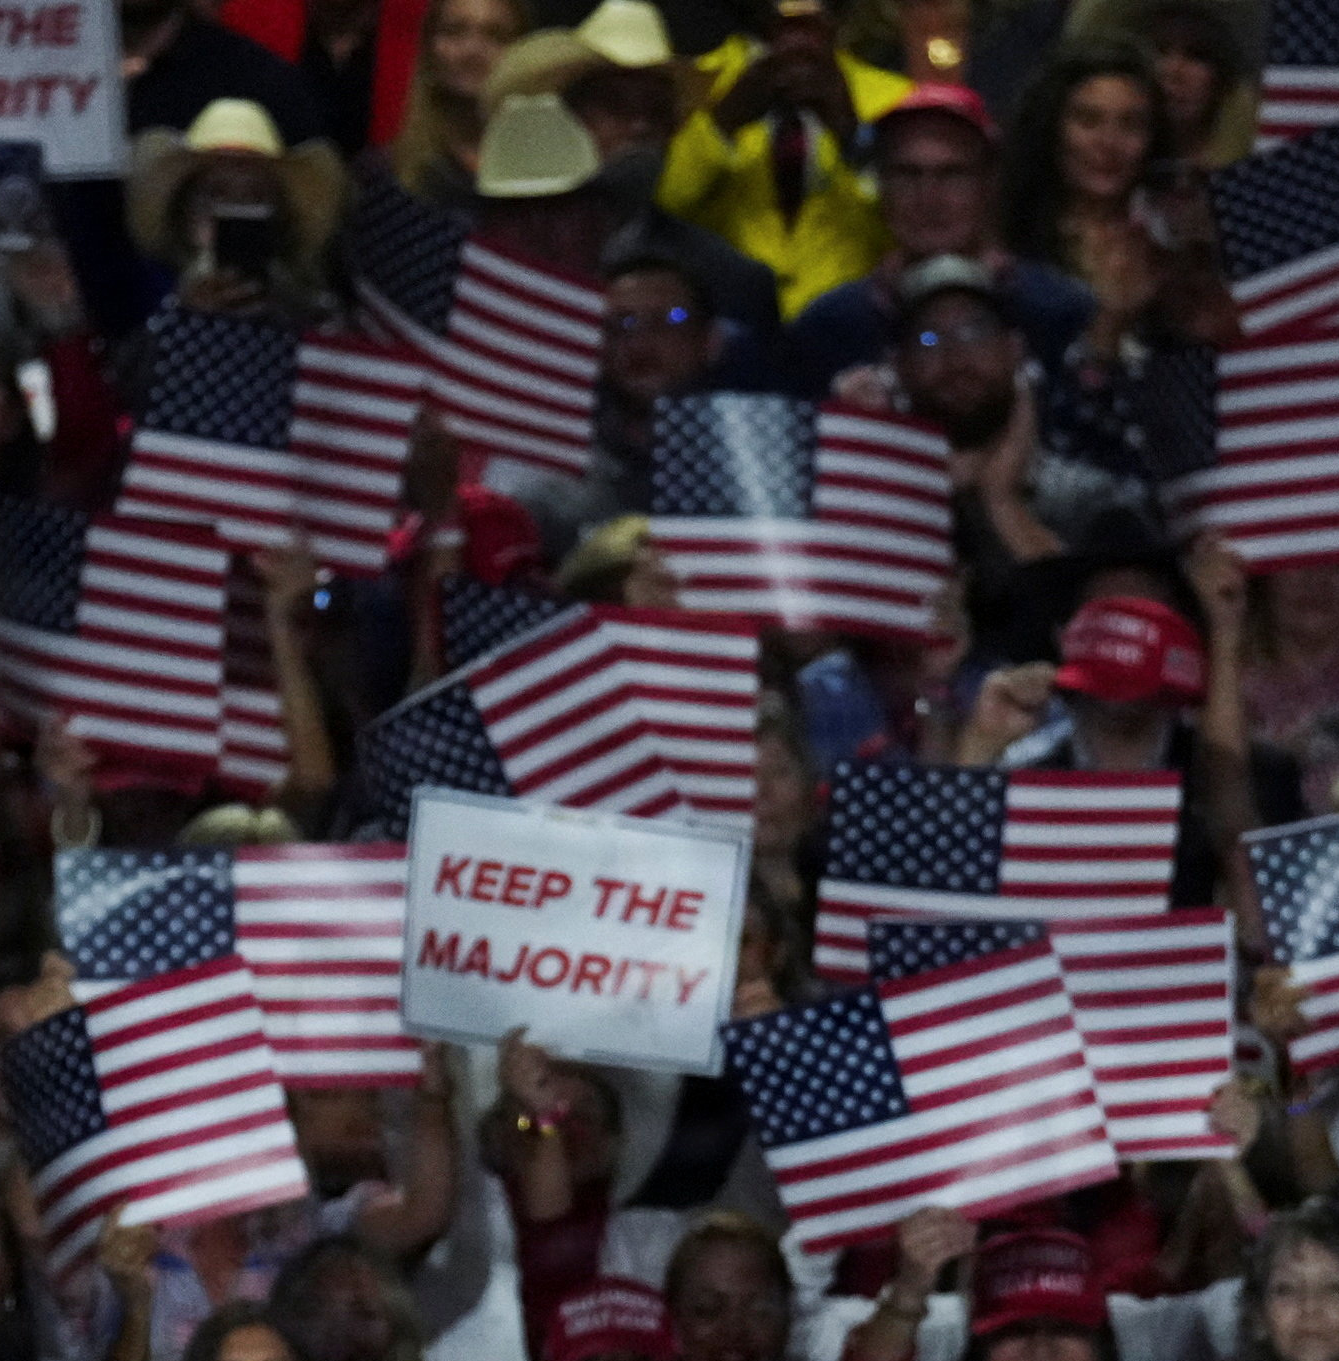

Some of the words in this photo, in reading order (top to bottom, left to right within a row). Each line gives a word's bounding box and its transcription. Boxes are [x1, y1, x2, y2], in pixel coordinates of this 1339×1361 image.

[434, 854, 573, 909] KEEP
[593, 878, 705, 931] THE
[417, 929, 709, 1005] MAJORITY
